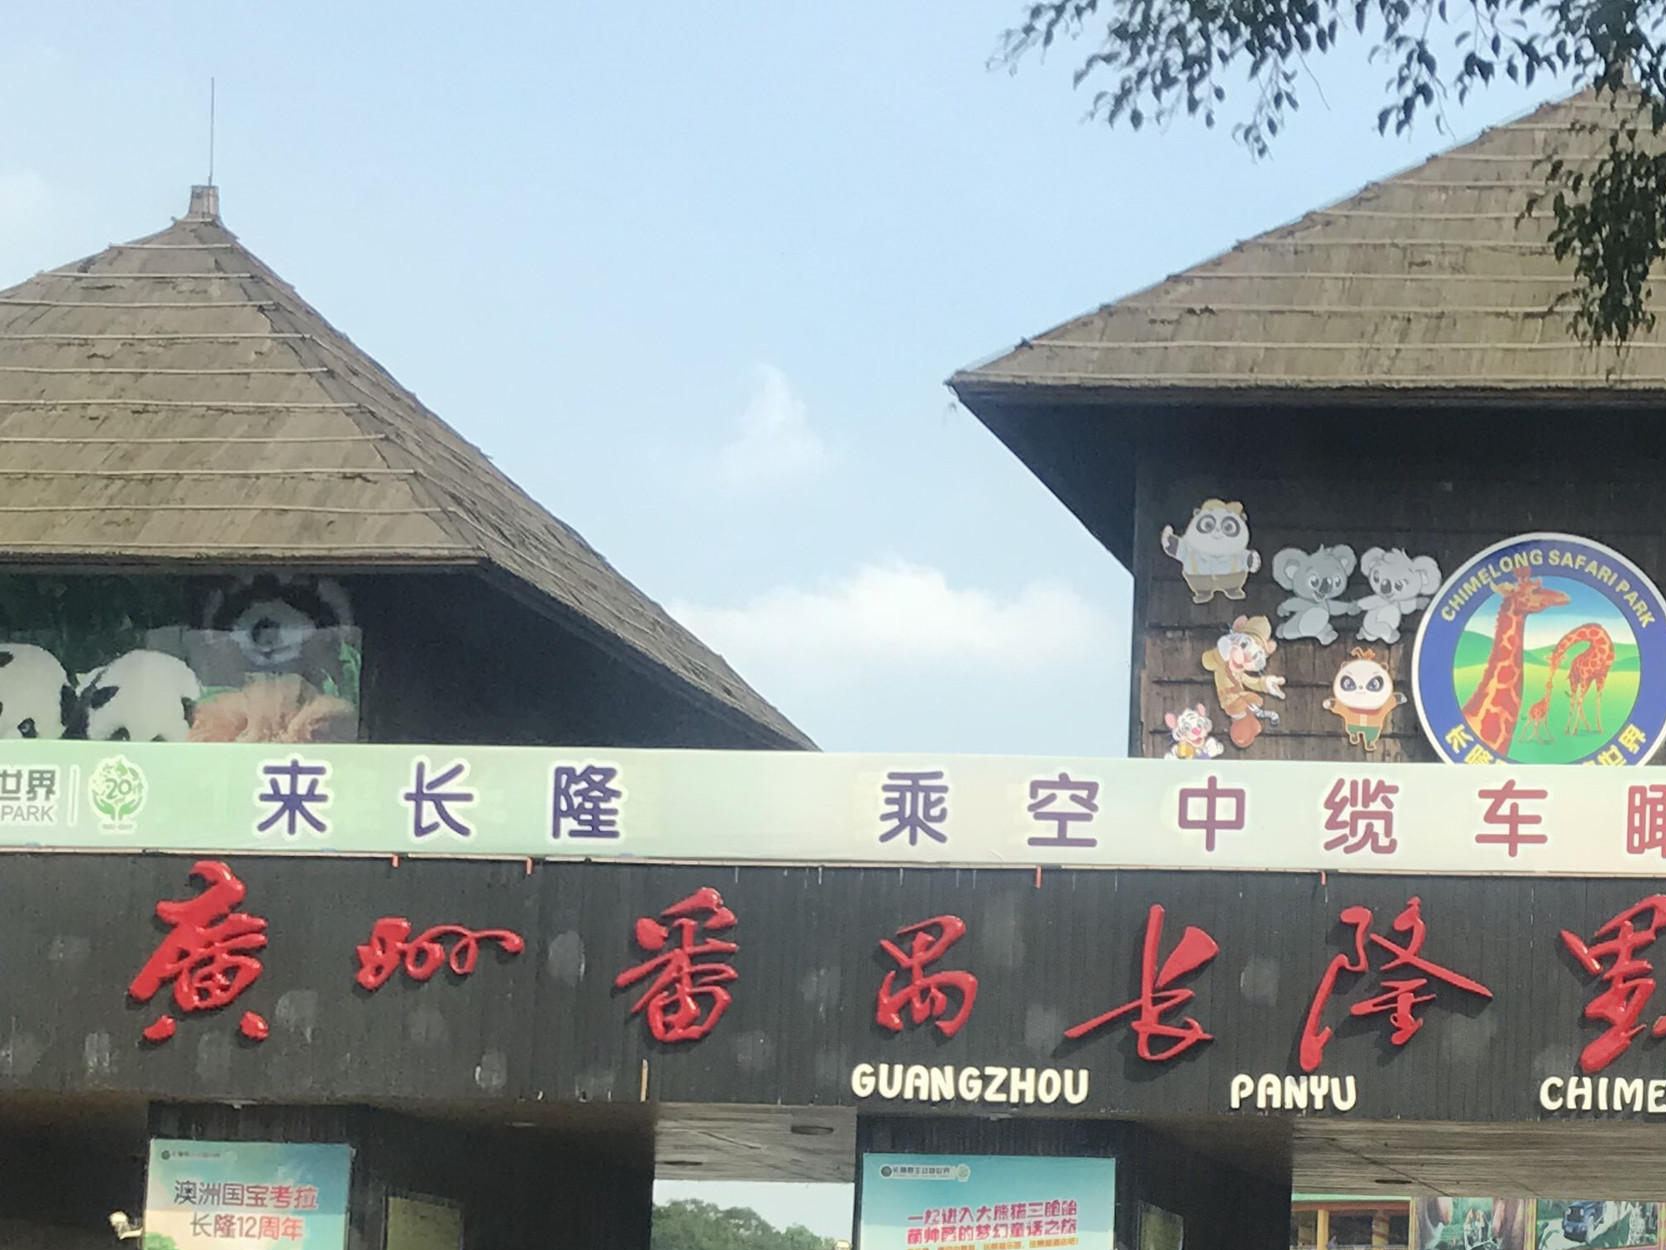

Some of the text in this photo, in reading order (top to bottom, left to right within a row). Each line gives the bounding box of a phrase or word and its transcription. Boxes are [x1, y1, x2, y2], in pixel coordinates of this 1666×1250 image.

[1441, 549, 1656, 628] CHIMELONG SAFARI PARK
[1445, 723, 1647, 765] 长隆世界
[2, 804, 55, 823] PARK
[257, 759, 623, 841] 来长隆
[851, 1064, 1089, 1105] GUANGZHOU
[1230, 1074, 1357, 1111] PANYU
[174, 1180, 318, 1209] 澳洲国宝考拉
[190, 1212, 304, 1241] 长隆12周年
